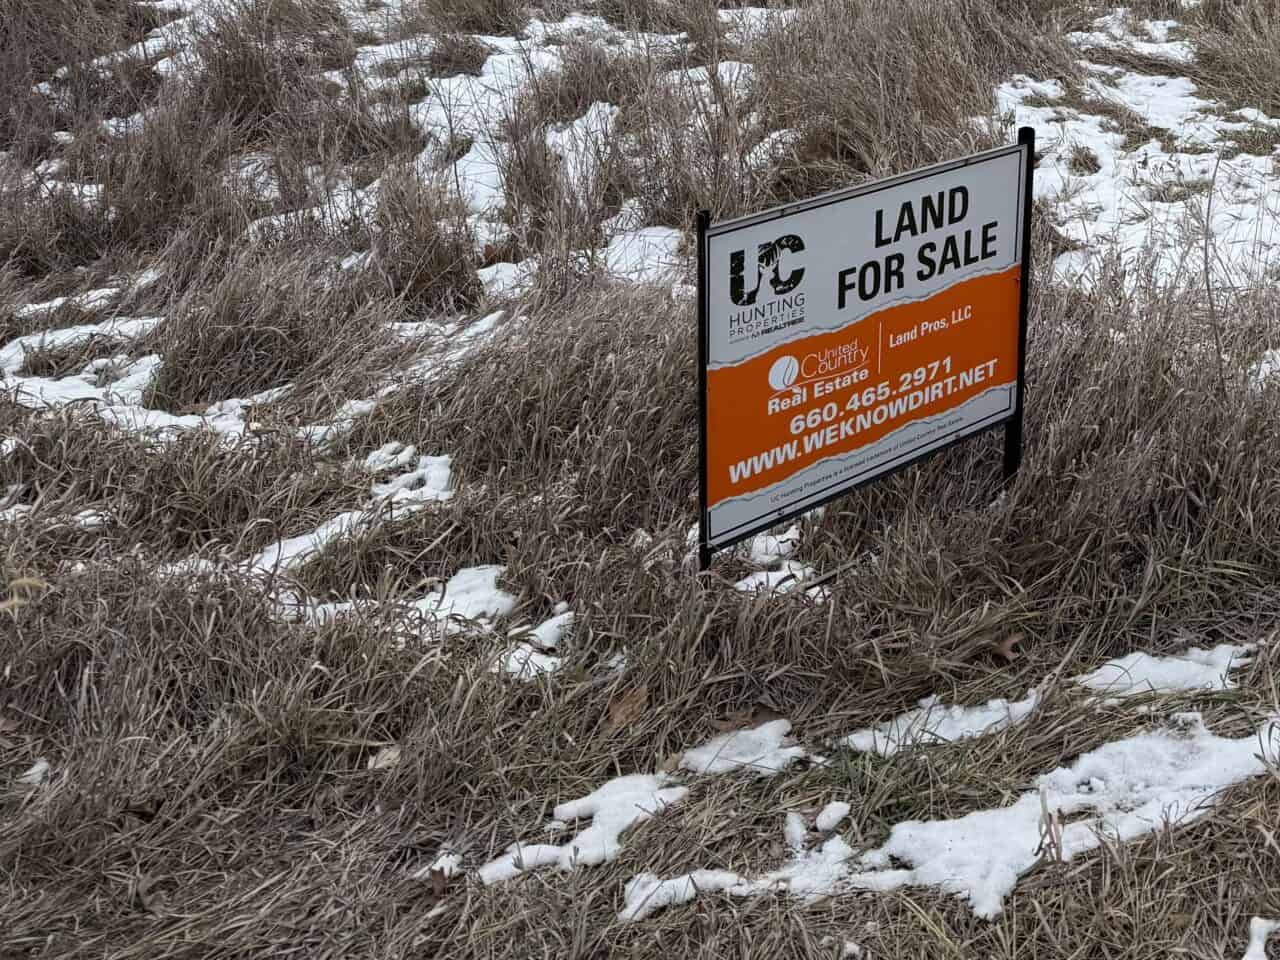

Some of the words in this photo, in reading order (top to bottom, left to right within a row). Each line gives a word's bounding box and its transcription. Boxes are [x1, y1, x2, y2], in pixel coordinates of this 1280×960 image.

[874, 184, 969, 249] LAND
[837, 253, 905, 310] FOR
[916, 221, 998, 282] SALE
[729, 293, 805, 329] HUNTING
[729, 307, 805, 337] PROPERTIES
[889, 325, 918, 349] Land
[920, 316, 948, 336] Pros,
[951, 305, 972, 324] LLC
[801, 345, 869, 379] Country
[817, 338, 858, 363] United
[767, 386, 807, 416] Real
[813, 367, 870, 398] Estate
[789, 356, 952, 435] 660.465.2971
[729, 359, 998, 484] WWW.WEKNOWDIRT.NET
